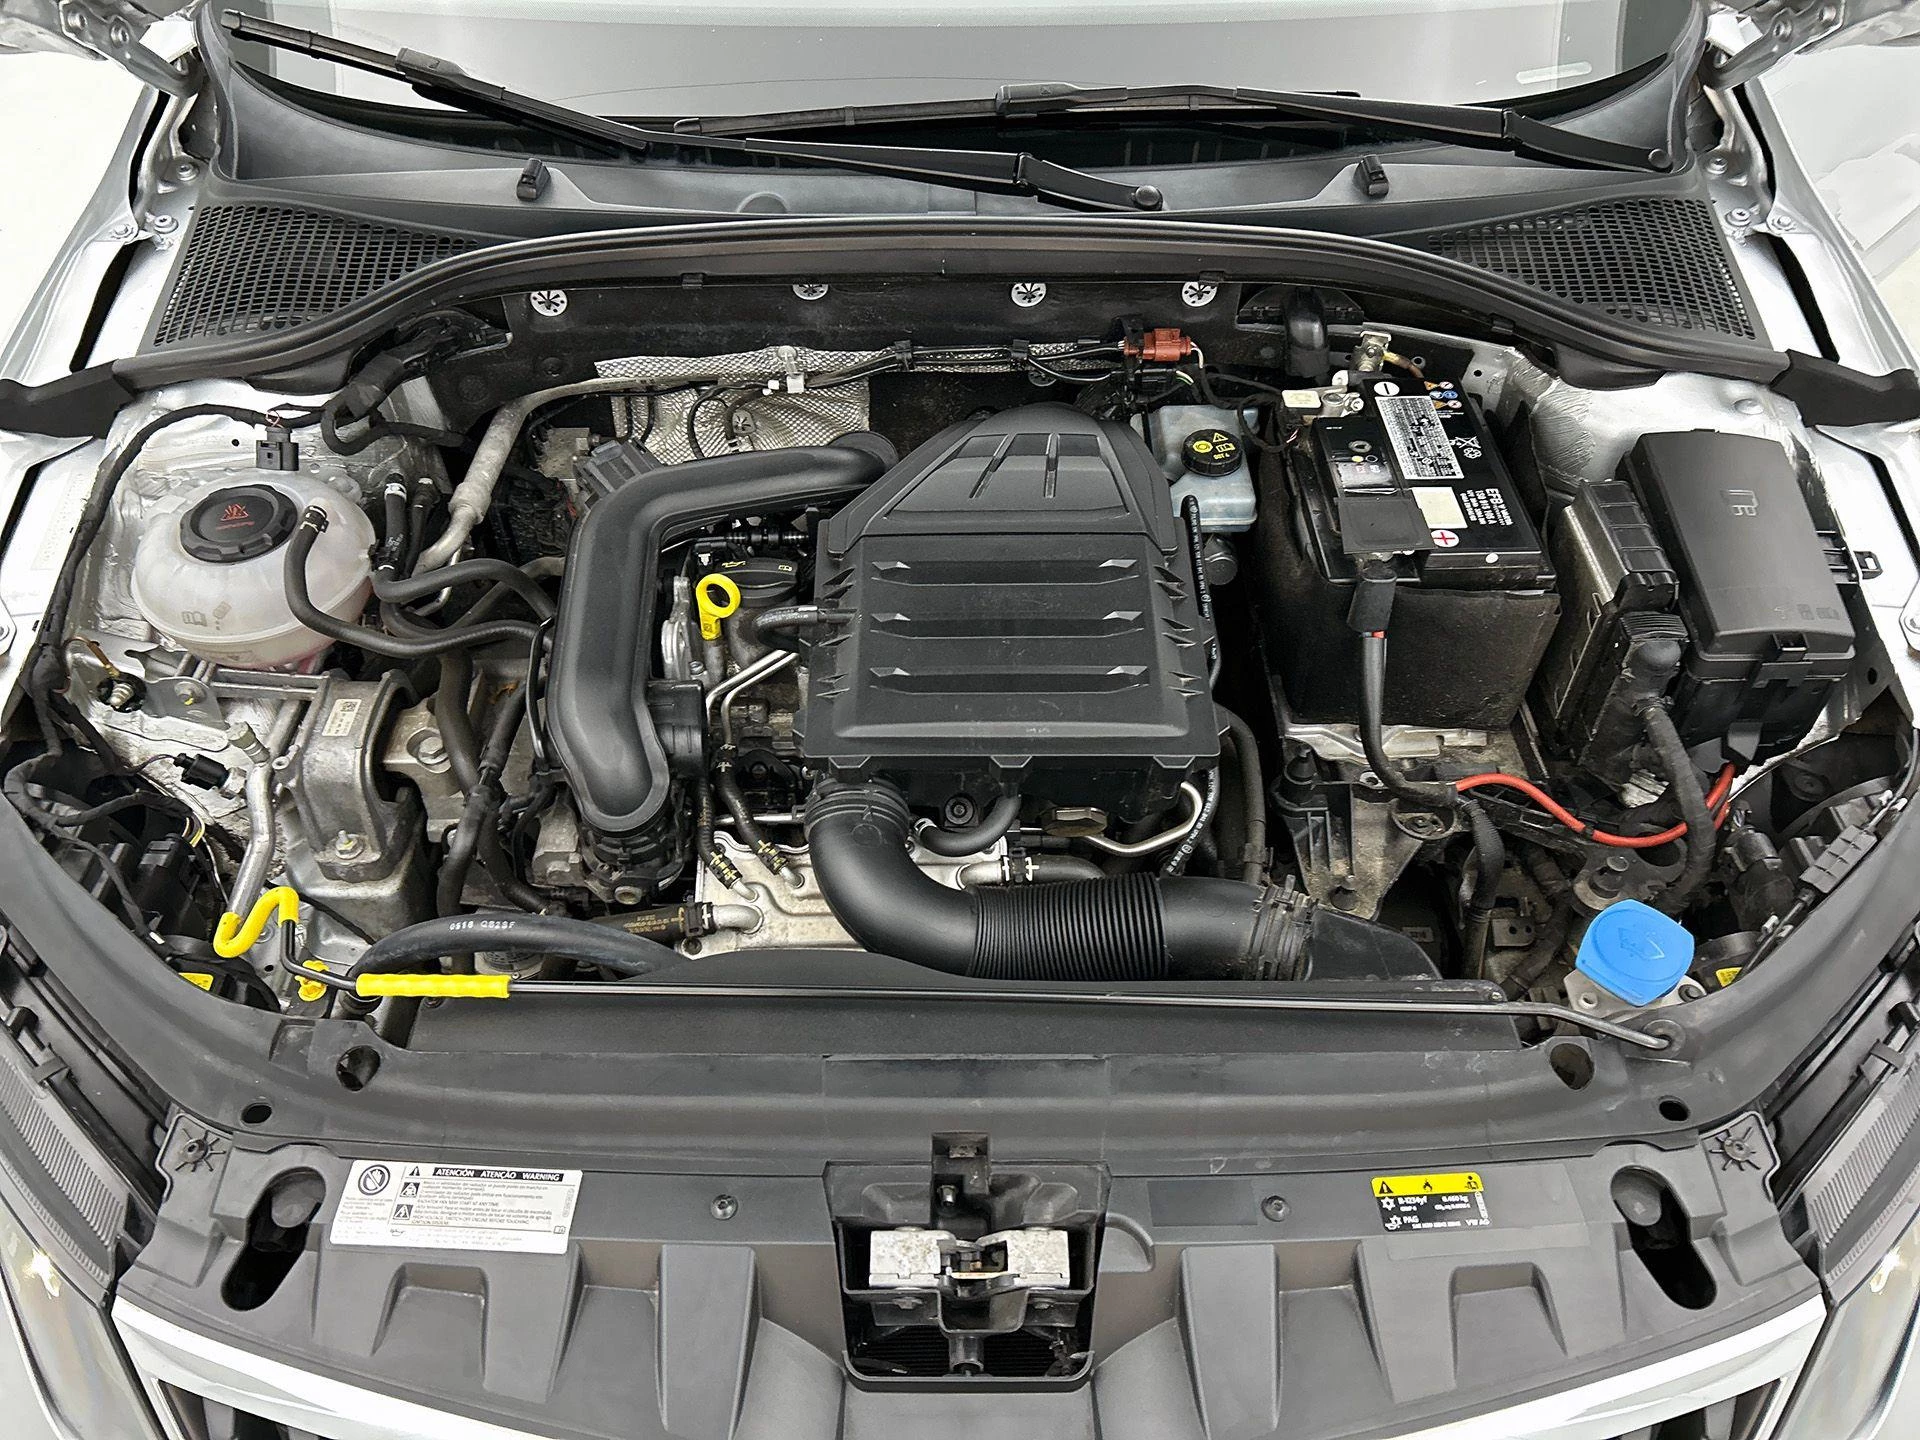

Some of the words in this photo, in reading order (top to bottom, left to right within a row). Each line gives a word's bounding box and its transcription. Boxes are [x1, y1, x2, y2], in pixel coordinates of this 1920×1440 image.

[1485, 488, 1504, 505] EFB
[436, 1167, 475, 1177] ATENCIÓN
[480, 1170, 517, 1180] ATENÇÃO
[522, 1172, 560, 1182] WARNING
[1402, 1215, 1419, 1223] PAG
